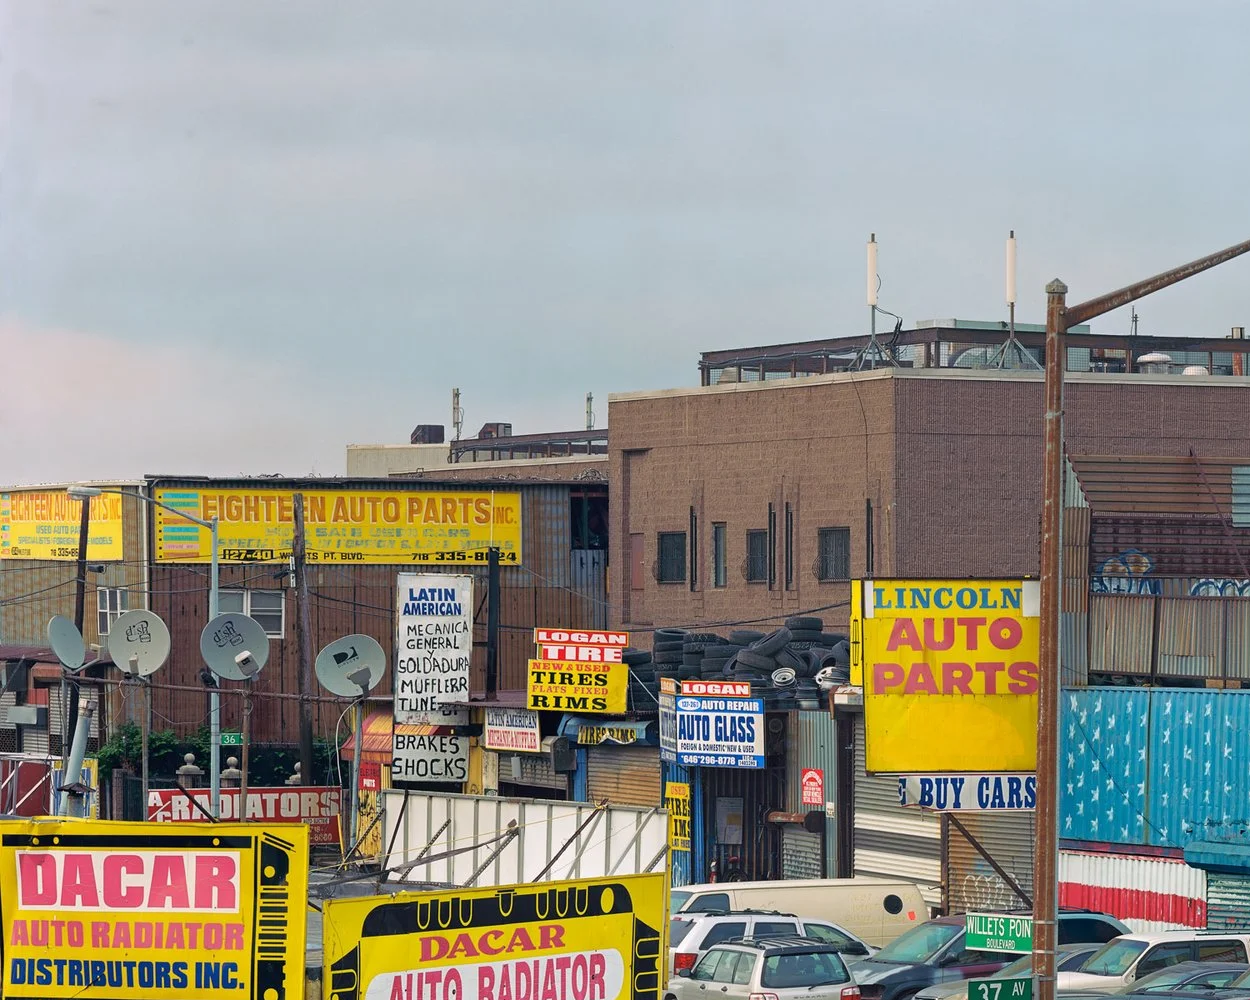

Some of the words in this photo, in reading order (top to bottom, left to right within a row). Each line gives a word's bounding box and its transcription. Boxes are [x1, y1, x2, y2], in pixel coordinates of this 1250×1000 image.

[11, 494, 53, 521] EIGHTEEN
[331, 496, 401, 524] AUTO
[407, 497, 491, 525] PARTS
[223, 549, 274, 560] 127-40
[323, 552, 337, 560] PT.
[341, 553, 365, 561] BLVD.
[412, 553, 430, 561] 718
[435, 552, 518, 562] 335-824
[409, 588, 456, 602] LATIN
[873, 587, 1023, 609] LINCOLN
[403, 602, 462, 616] AMERICAN
[407, 621, 469, 636] MECANICA
[886, 616, 1023, 652] AUTO
[406, 635, 460, 650] GENERAL
[538, 631, 627, 645] LOGAN
[427, 650, 435, 659] Y
[542, 645, 622, 662] TIRE
[398, 656, 469, 674] SOLDADURA
[532, 662, 564, 672] NEW
[566, 663, 574, 672] &
[575, 663, 611, 672] USED
[401, 676, 468, 694] MUFFLERR
[532, 671, 608, 687] TIRES
[873, 661, 1039, 695] PARTS
[532, 685, 567, 694] FLATS
[573, 686, 609, 696] FIXED
[683, 683, 749, 695] LOGAN
[531, 695, 607, 710] RIMS
[701, 700, 725, 710] AUTO
[727, 701, 759, 711] REPAIR
[505, 713, 537, 728] AMERICAN
[678, 714, 710, 741] AUTO
[714, 715, 755, 743] GLASS
[223, 735, 236, 744] 36
[395, 735, 460, 754] BRAKES
[702, 744, 725, 752] DOMESTIC
[742, 745, 755, 753] USED
[391, 757, 466, 779] SHOCKS
[919, 777, 964, 810] BUY
[977, 776, 1037, 810] CARS
[171, 791, 340, 819] RADIATORS
[18, 853, 237, 909] DACAR
[967, 916, 1005, 937] WILLETS
[11, 920, 84, 947] AUTO
[91, 921, 245, 951] RADIATOR
[419, 924, 566, 962] DACAR
[986, 938, 1016, 950] BOULEVARD
[11, 958, 188, 989] DISTRIBUTORS
[195, 962, 245, 990] INC.
[1012, 981, 1025, 996] AV
